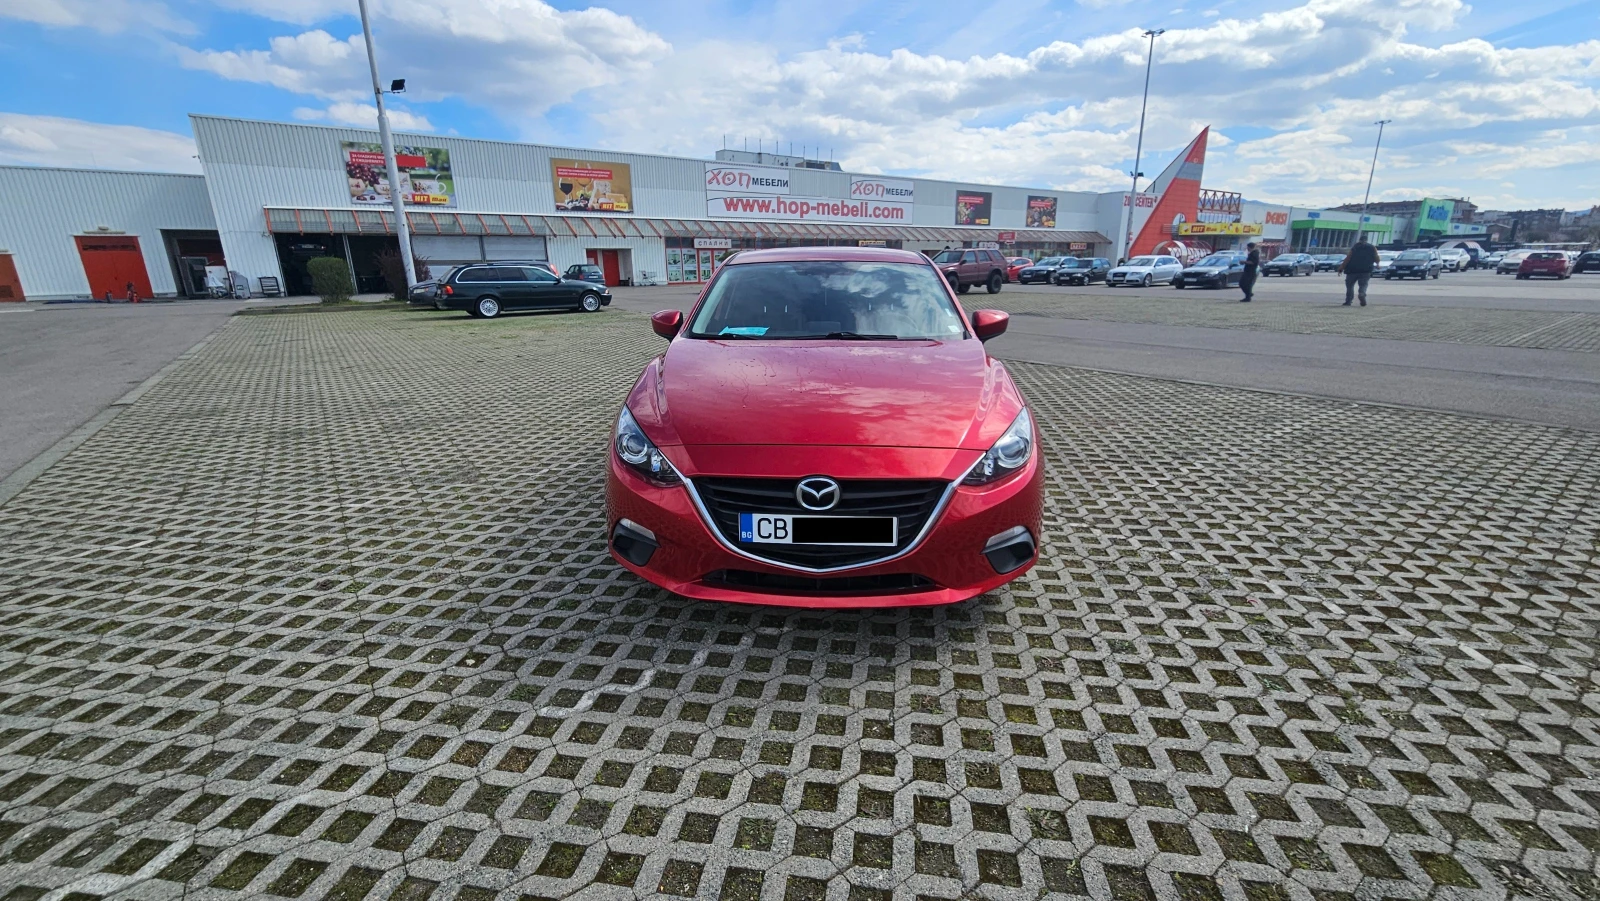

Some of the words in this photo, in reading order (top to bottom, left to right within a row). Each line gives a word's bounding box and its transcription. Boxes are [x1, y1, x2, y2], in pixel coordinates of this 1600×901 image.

[707, 169, 750, 189] ХОП
[752, 176, 789, 188] МЕБЕЛИ
[852, 181, 885, 198] ХОП
[885, 186, 914, 197] МЕБЕЛИ
[723, 196, 904, 219] www.hop-mebeli.com
[1135, 196, 1154, 208] CENTER
[741, 531, 753, 539] BG
[757, 517, 789, 540] CB
